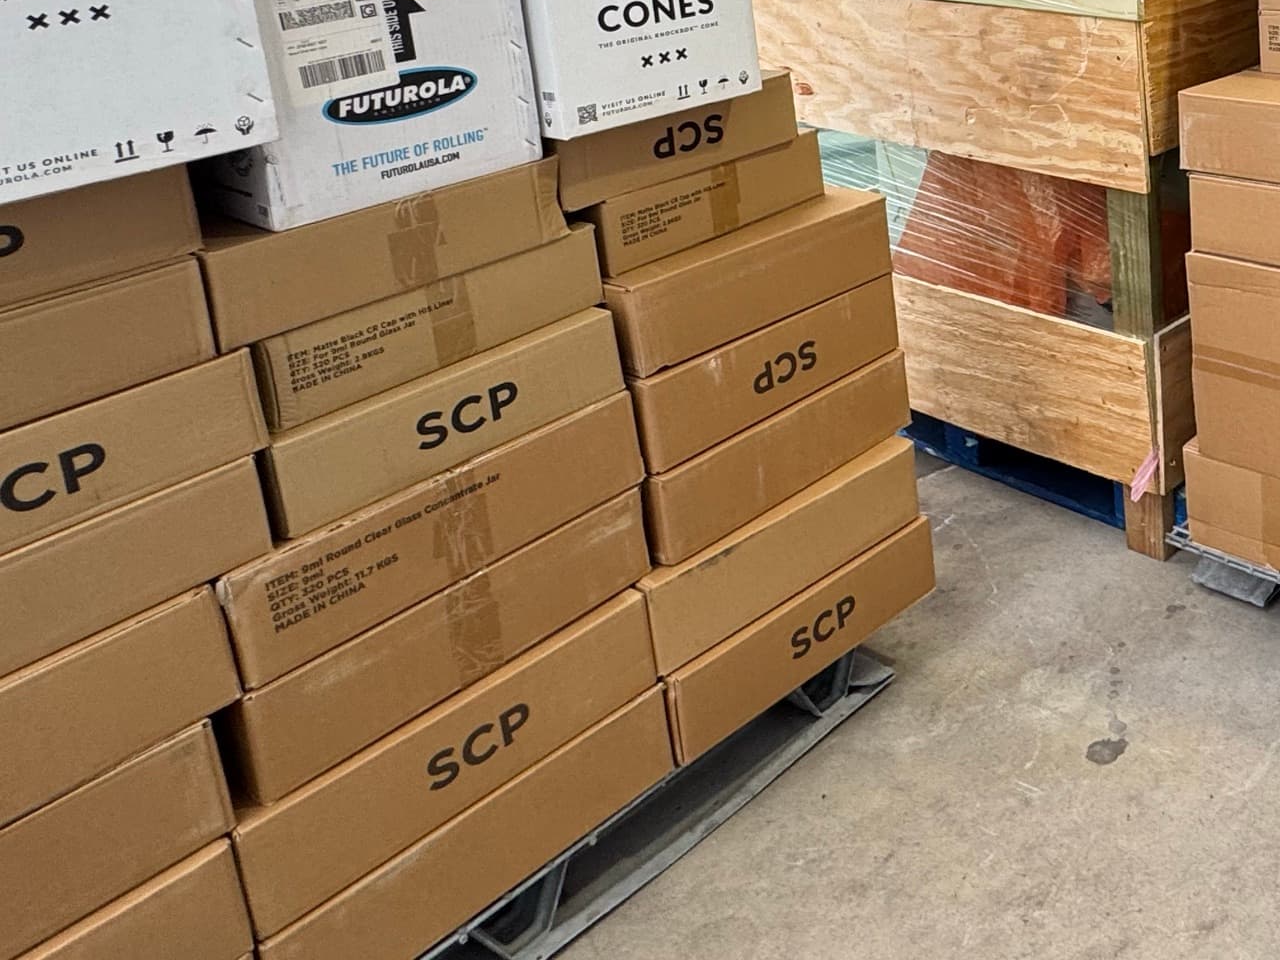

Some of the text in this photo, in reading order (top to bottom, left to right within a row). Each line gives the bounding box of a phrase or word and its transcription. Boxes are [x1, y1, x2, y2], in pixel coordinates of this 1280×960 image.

[385, 9, 400, 32] SIDE
[389, 32, 405, 54] THIS
[598, 41, 613, 50] THE
[615, 34, 653, 48] ORIGINAL
[338, 75, 466, 118] FUTUROLA
[601, 100, 623, 110] VISIT
[637, 90, 666, 102] ONLINE
[332, 129, 485, 177] THE FUTURE OF ROLLING
[653, 114, 725, 160] SCP
[17, 161, 36, 172] US
[42, 149, 98, 167] ONLINE
[381, 152, 460, 180] FUTUROLAUSA.COM
[313, 340, 338, 353] Matte
[340, 330, 364, 343] Black
[366, 324, 379, 334] CR
[380, 319, 397, 330] Cap
[399, 311, 417, 322] with
[313, 351, 329, 361] For
[350, 333, 378, 348] Round
[379, 326, 401, 338] Glass
[403, 320, 416, 330] Jar
[332, 351, 350, 363] PCS
[333, 363, 362, 378] CHINA
[753, 340, 818, 394] SCP
[416, 381, 518, 450] SCP
[265, 570, 298, 591] ITEM:
[327, 539, 362, 563] Round
[364, 525, 392, 544] Clear
[395, 511, 422, 529] Glass
[486, 473, 500, 486] Jar
[267, 582, 299, 602] SIZE:
[270, 593, 300, 612] QTY:
[327, 568, 349, 585] PCS
[272, 602, 306, 622] Gross
[308, 578, 352, 603] Weight:
[376, 553, 399, 571] KGS
[275, 582, 366, 633] MADE IN CHINA
[790, 595, 856, 660] SCP
[426, 703, 530, 792] SCP
